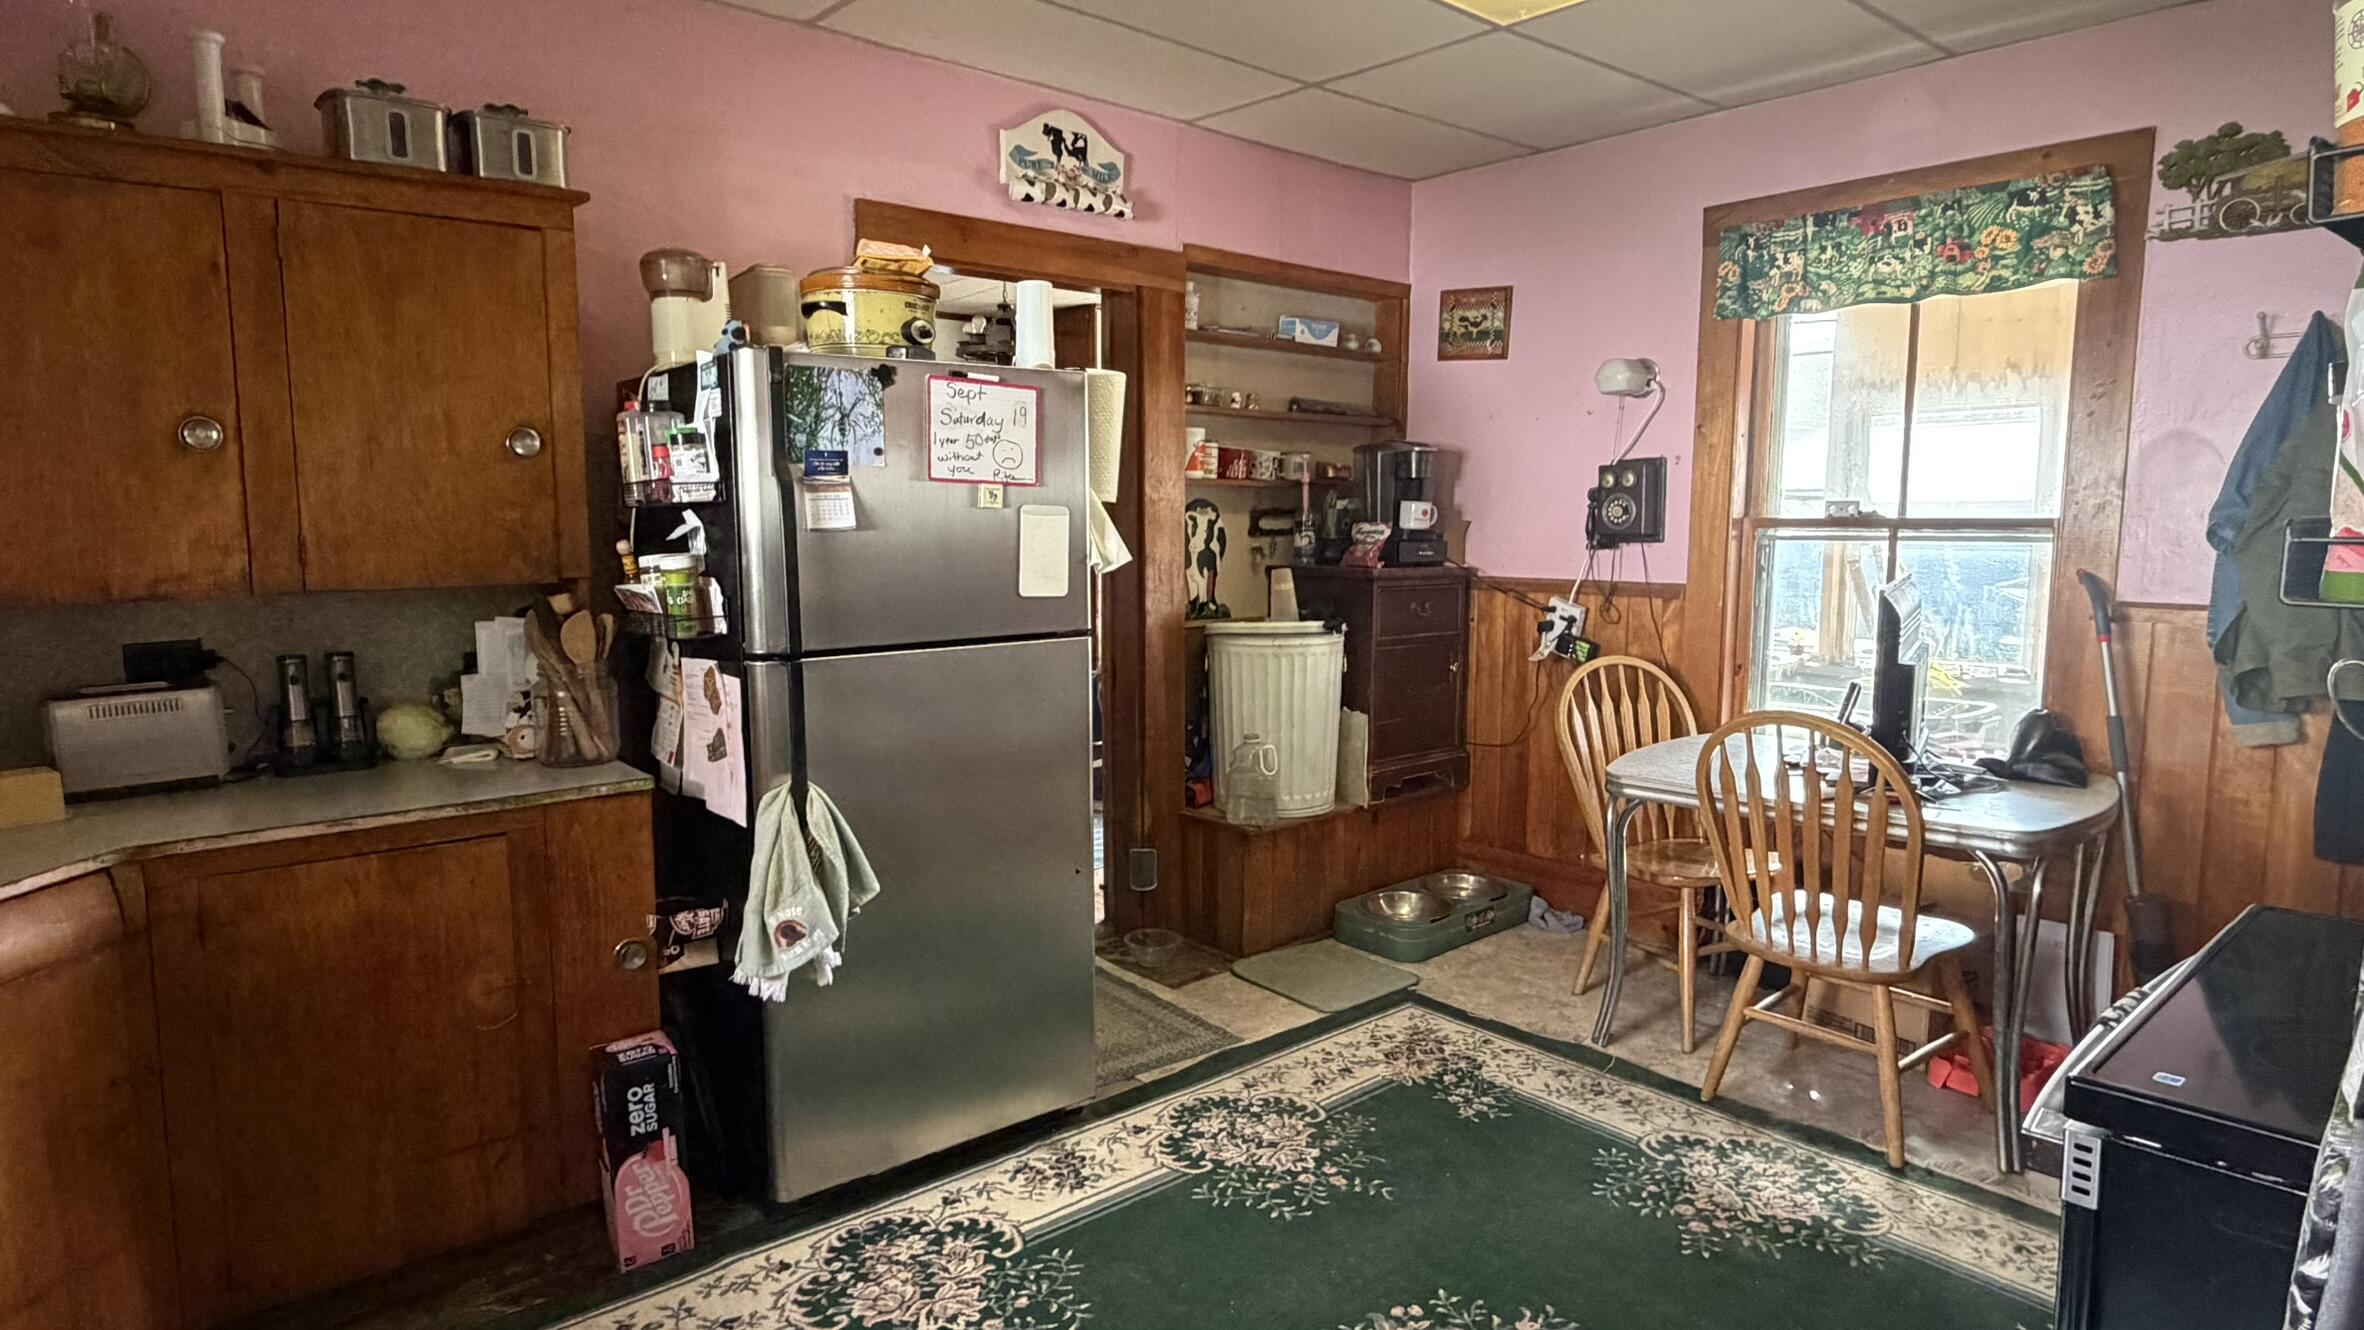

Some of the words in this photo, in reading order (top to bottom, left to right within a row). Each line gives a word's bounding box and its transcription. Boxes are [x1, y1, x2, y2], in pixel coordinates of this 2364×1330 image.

[945, 381, 988, 405] Sept
[940, 407, 1005, 433] Saturday
[1013, 405, 1028, 428] 19
[939, 436, 960, 449] year
[965, 432, 984, 450] 50
[937, 451, 984, 462] without
[947, 465, 975, 477] you
[626, 1086, 646, 1137] zero
[643, 1083, 658, 1132] SUGAR
[625, 1184, 652, 1216] Dr
[632, 1161, 679, 1236] Pepper
